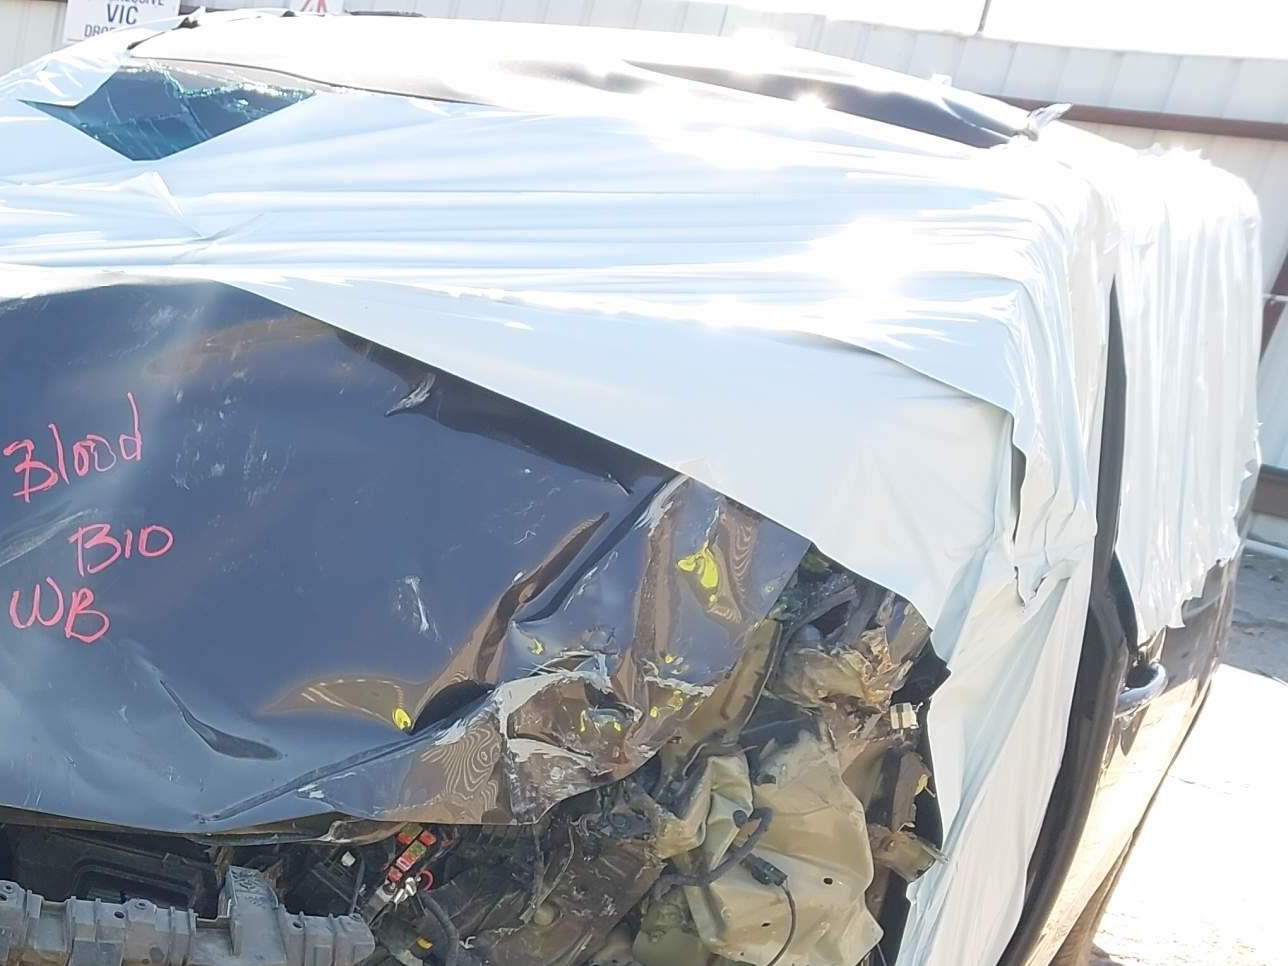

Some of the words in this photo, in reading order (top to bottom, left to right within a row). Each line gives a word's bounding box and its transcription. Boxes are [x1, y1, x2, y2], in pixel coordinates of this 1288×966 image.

[107, 3, 139, 25] VIC
[2, 391, 143, 503] Blood
[68, 523, 174, 577] BIO
[9, 576, 110, 644] WB
